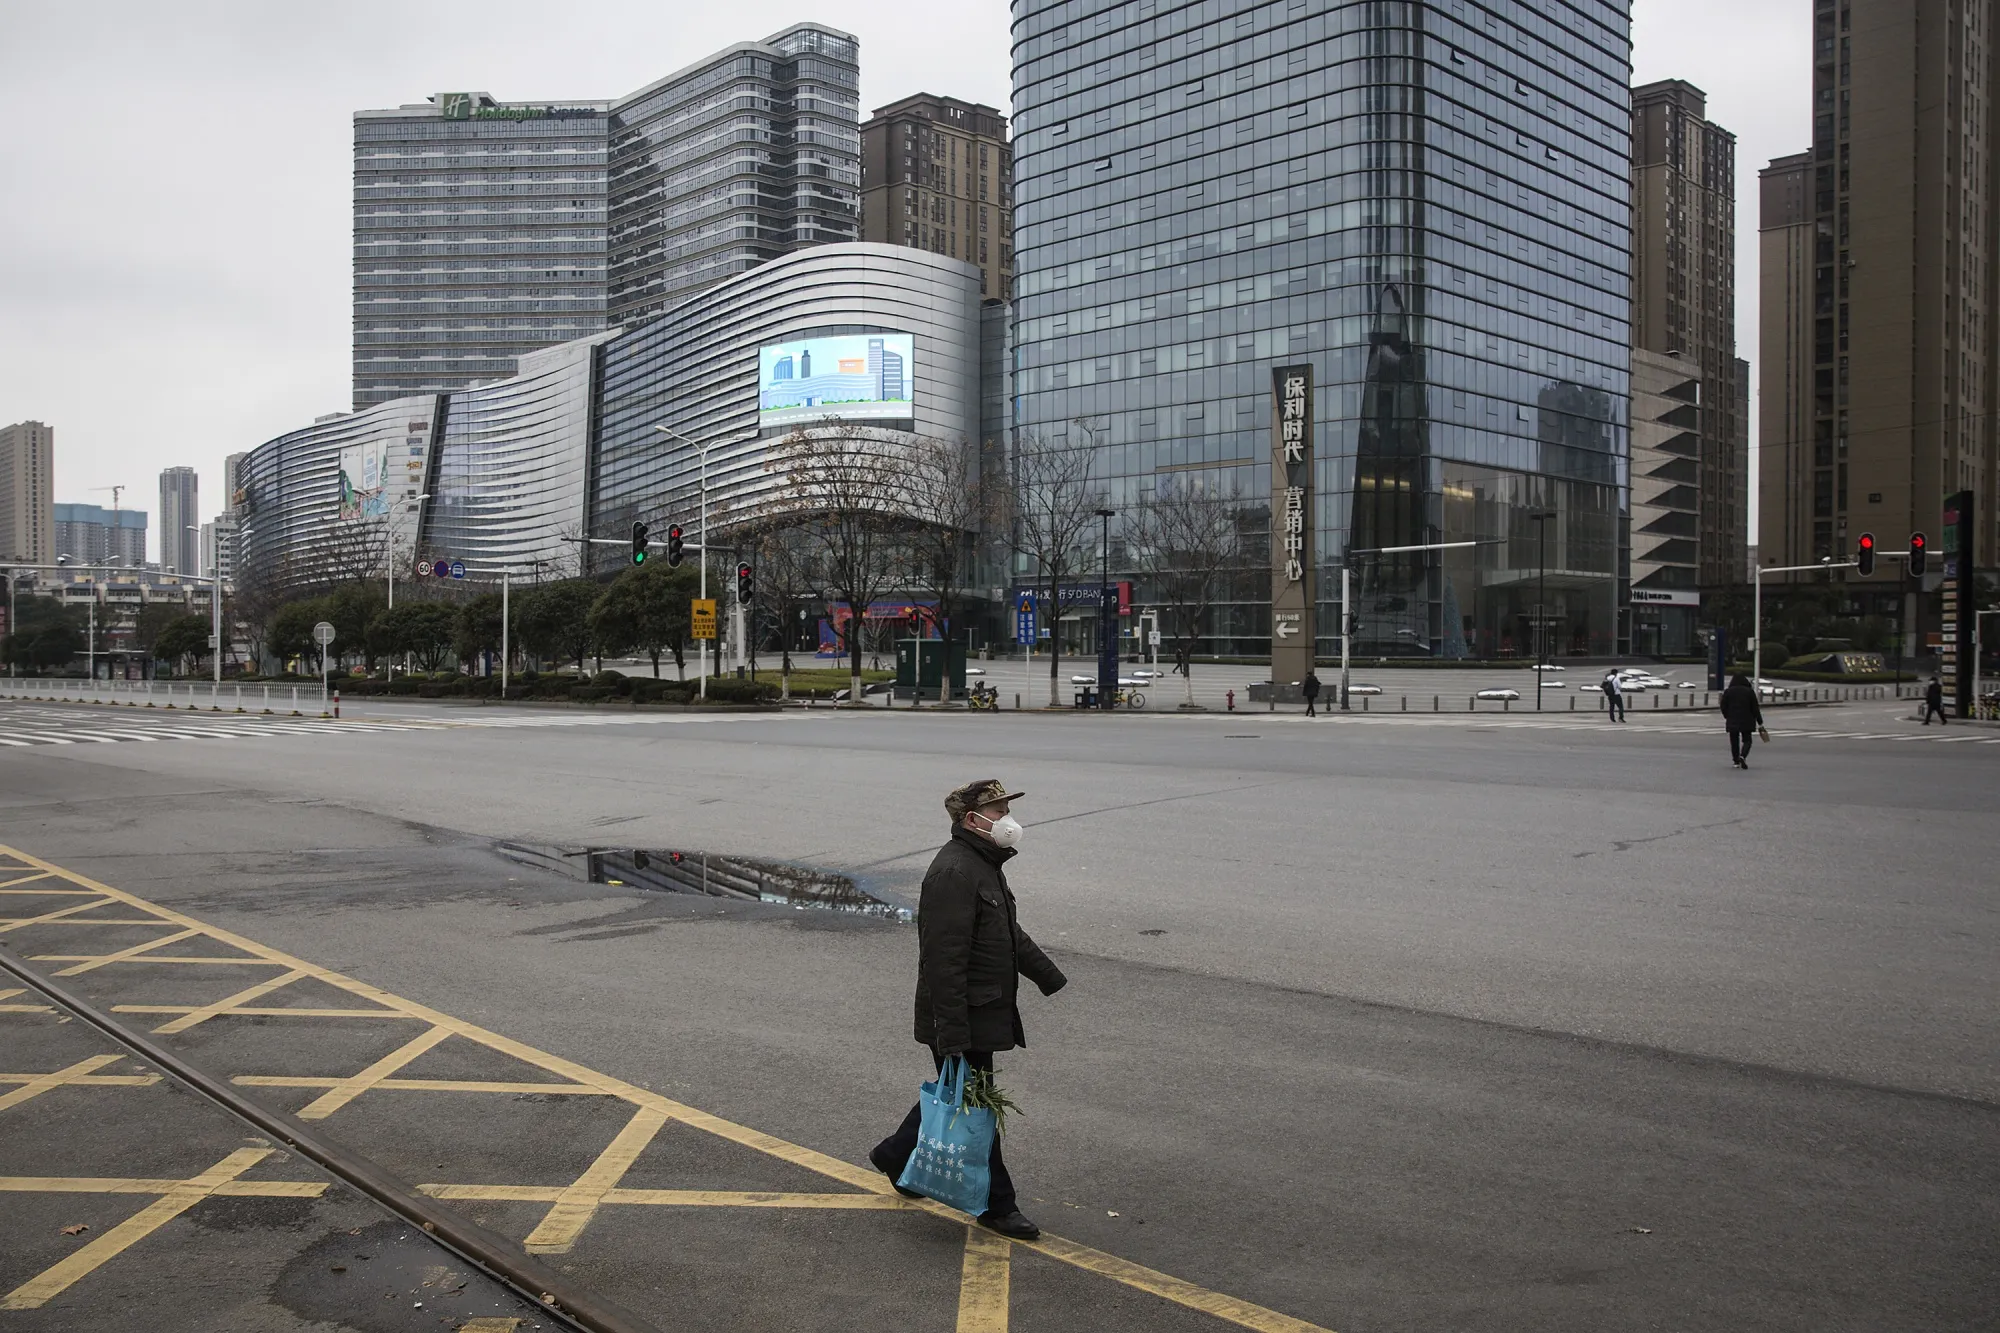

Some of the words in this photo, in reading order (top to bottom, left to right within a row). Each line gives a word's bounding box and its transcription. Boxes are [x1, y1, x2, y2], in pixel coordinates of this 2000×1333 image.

[476, 106, 522, 123] Holiday
[523, 105, 544, 118] Inn
[546, 106, 597, 122] Express
[1283, 377, 1305, 462] 保利时代
[1283, 486, 1305, 582] 营销中心
[419, 563, 429, 573] 60
[912, 1158, 965, 1183] 离非法集资
